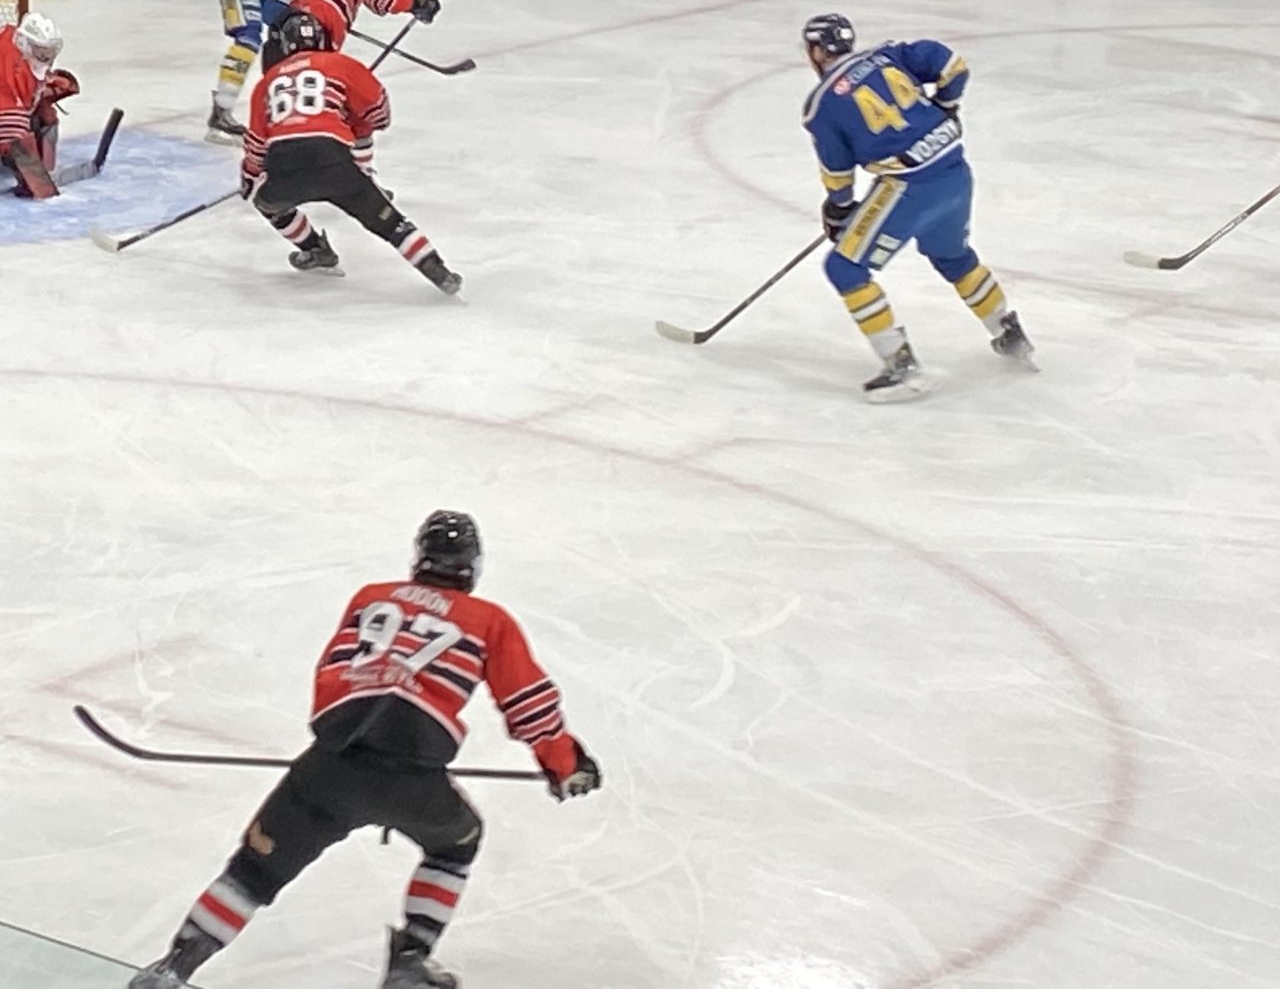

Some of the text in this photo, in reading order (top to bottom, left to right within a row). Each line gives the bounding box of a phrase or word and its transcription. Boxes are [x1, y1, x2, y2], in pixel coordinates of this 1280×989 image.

[268, 70, 325, 124] 68
[852, 66, 923, 134] 44
[351, 601, 463, 673] 97
